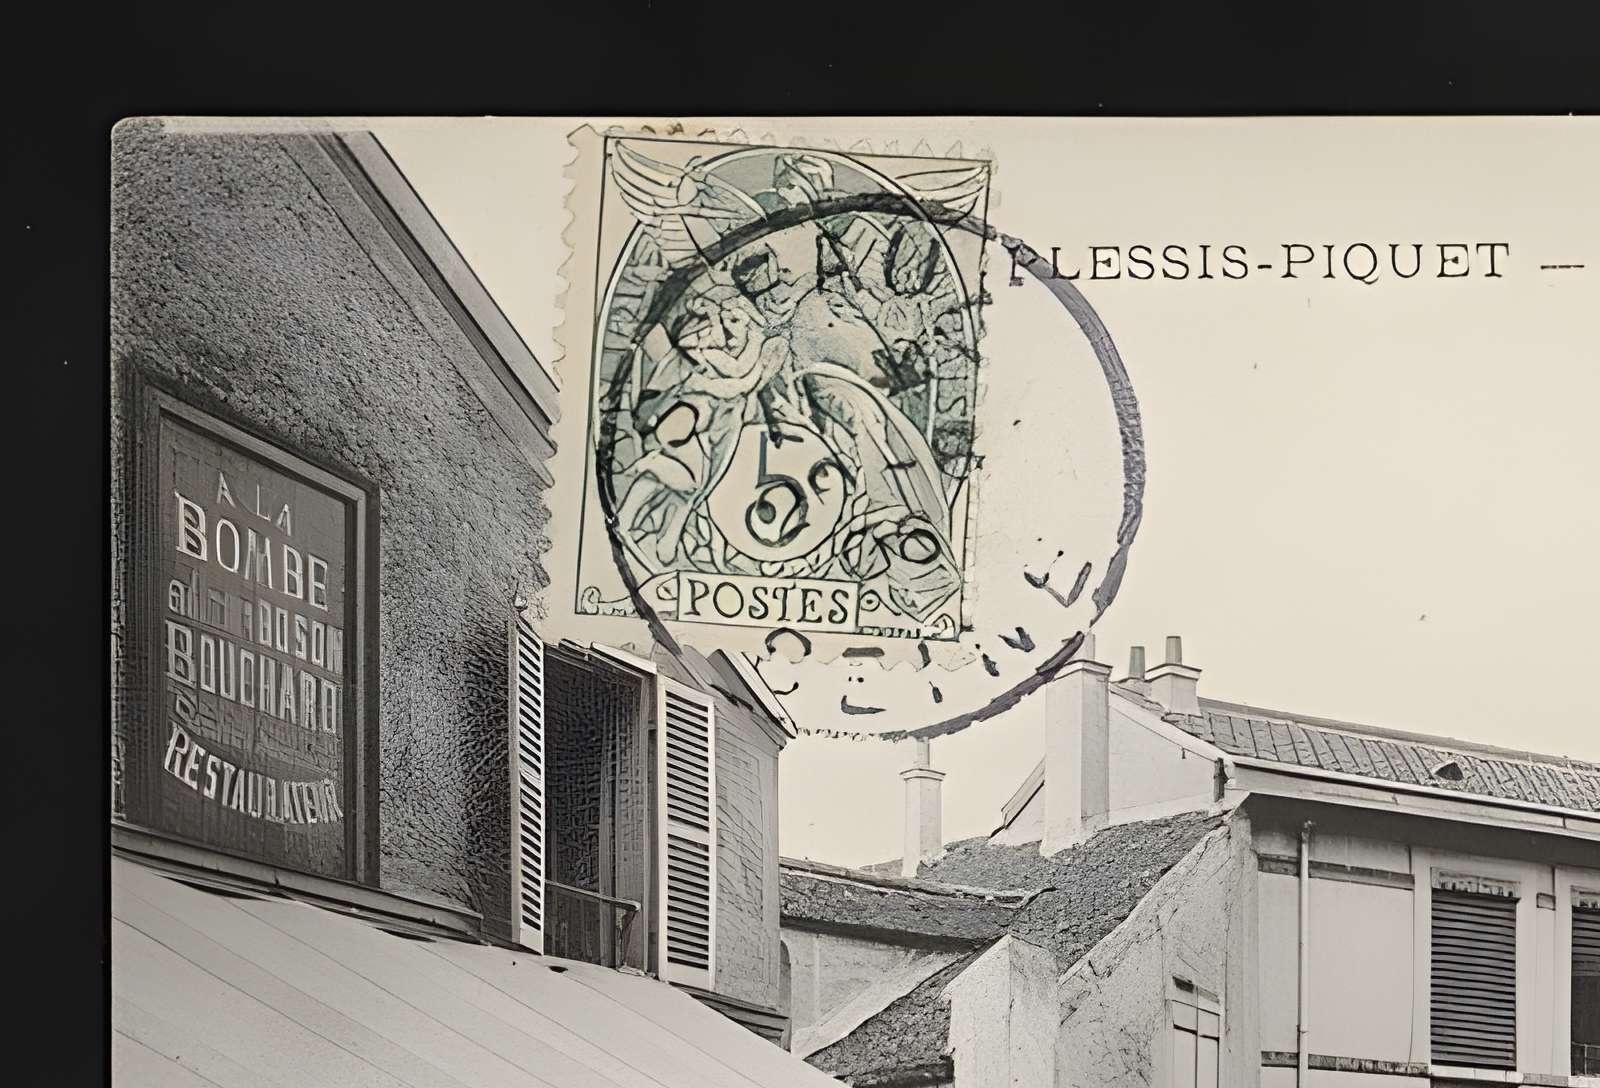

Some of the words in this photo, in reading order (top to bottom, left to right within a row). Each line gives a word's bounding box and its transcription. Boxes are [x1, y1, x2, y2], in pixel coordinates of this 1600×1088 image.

[215, 471, 237, 508] A
[255, 479, 292, 537] LA
[174, 489, 328, 612] BOMBE
[683, 577, 850, 626] POSTES
